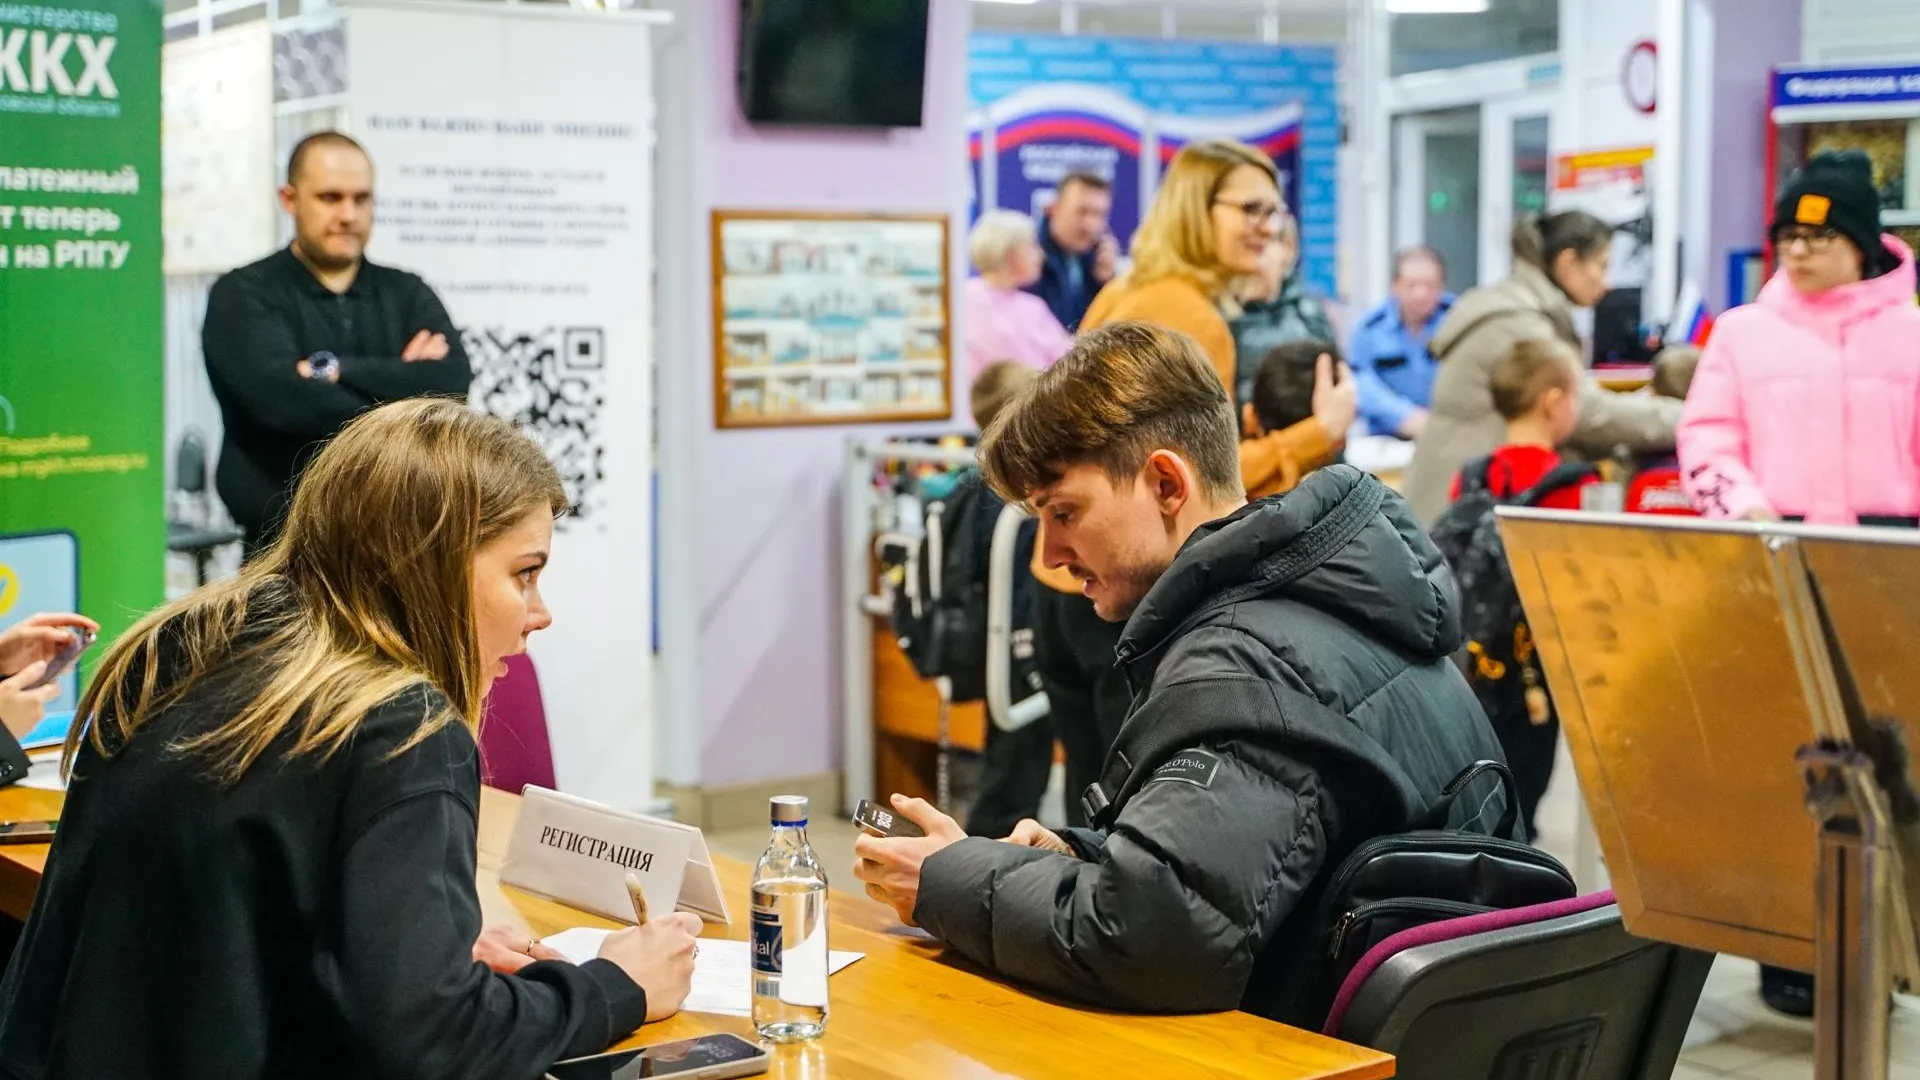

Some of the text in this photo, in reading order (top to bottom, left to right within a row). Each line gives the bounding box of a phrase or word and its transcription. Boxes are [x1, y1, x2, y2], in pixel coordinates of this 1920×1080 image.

[21, 206, 121, 236] теперь
[14, 244, 49, 268] на
[55, 239, 131, 269] РПГУ
[540, 825, 654, 873] РЕГИСТРАЦИЯ
